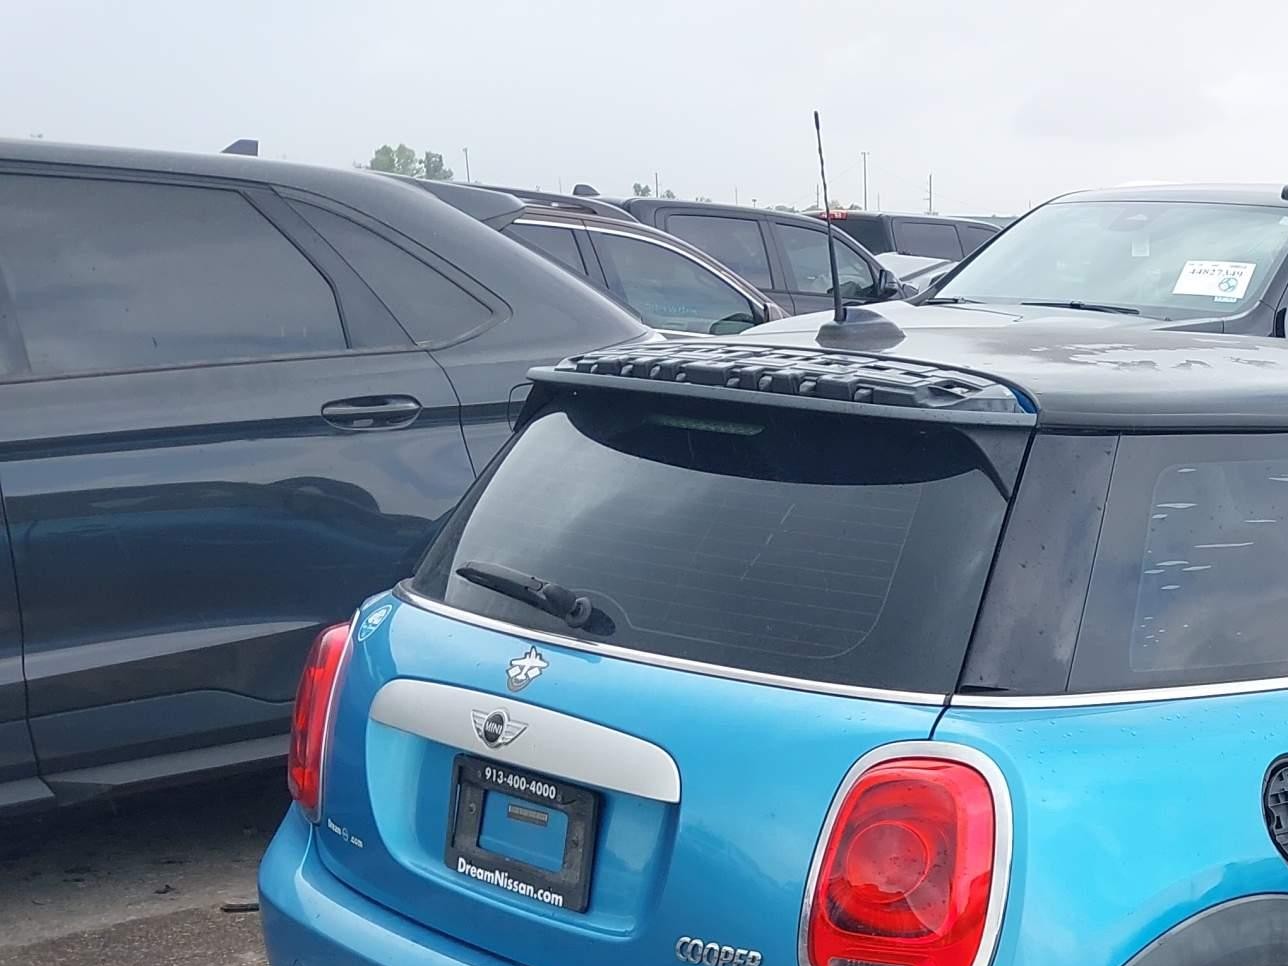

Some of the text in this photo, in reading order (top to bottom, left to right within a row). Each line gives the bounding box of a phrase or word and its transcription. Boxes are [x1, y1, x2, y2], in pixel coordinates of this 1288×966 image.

[486, 720, 503, 735] MINI
[485, 766, 557, 800] 913-400-4000
[457, 856, 564, 908] DreamNissan.com
